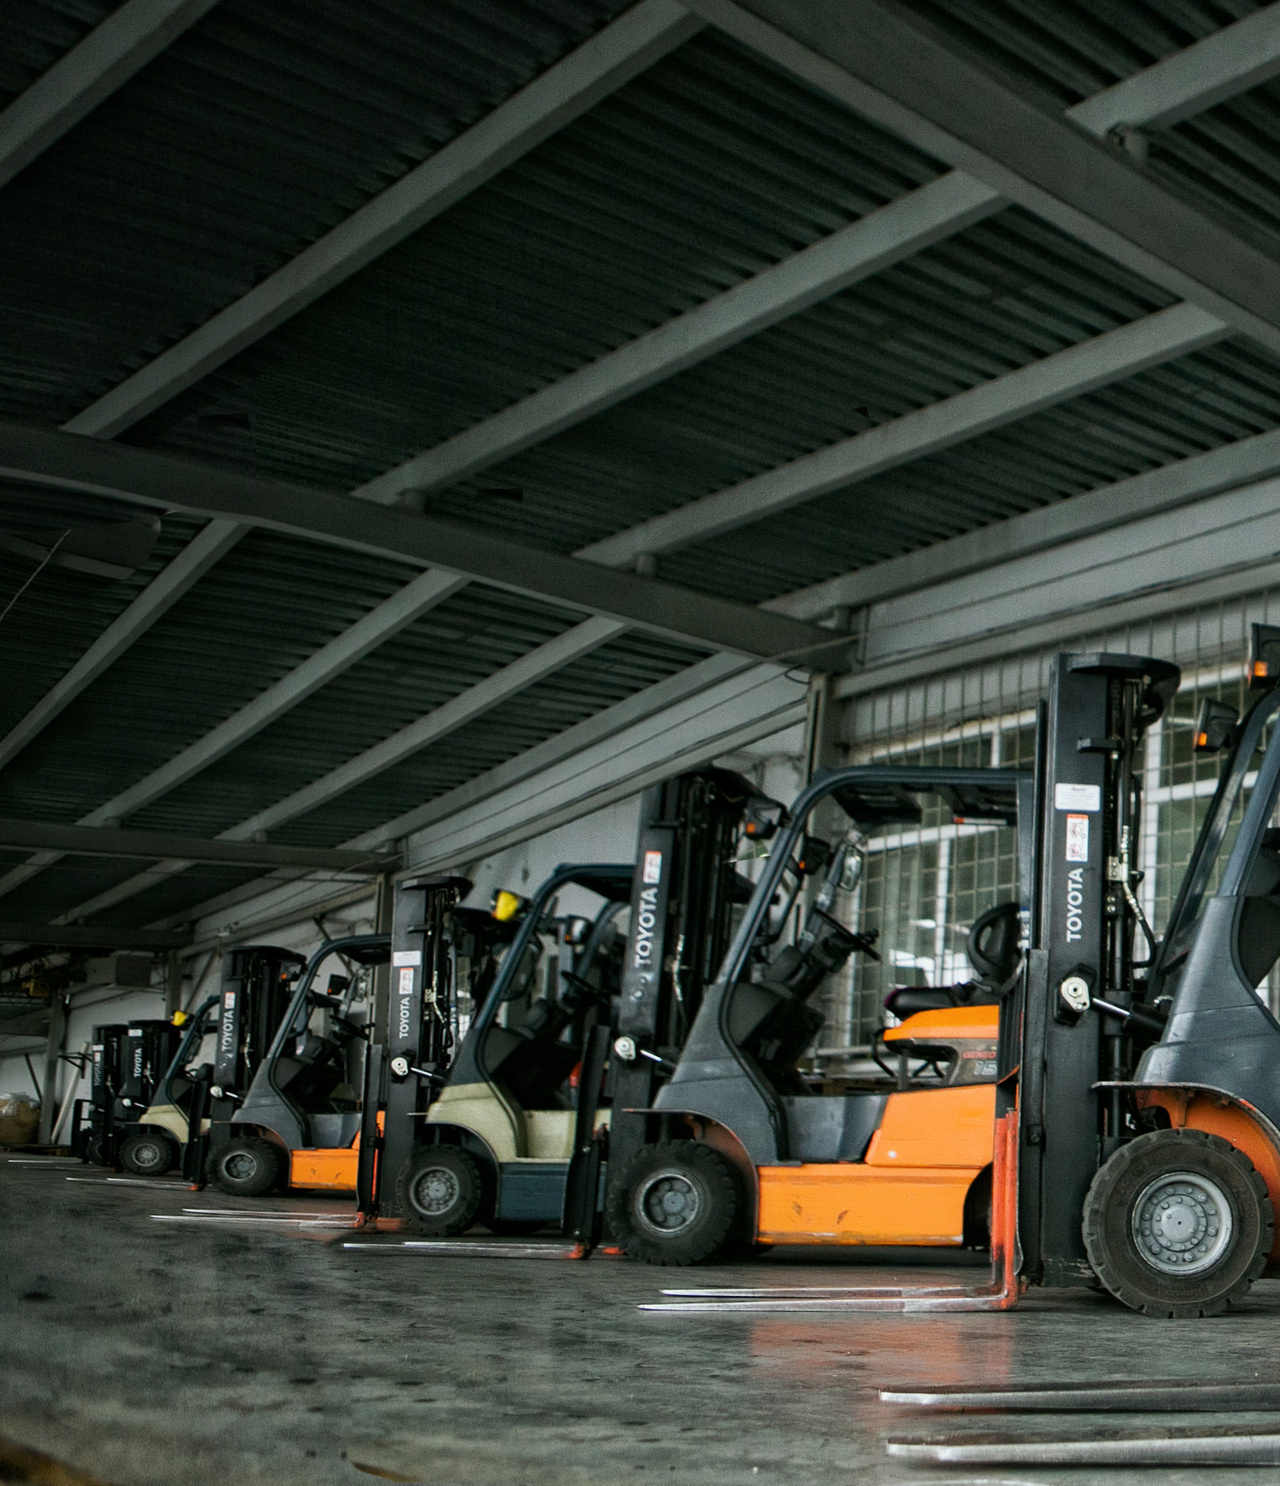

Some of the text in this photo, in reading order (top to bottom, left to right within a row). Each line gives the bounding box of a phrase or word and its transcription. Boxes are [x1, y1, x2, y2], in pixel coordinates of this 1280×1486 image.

[1066, 867, 1084, 943] TOYOTA
[634, 887, 659, 969] TOYOTA
[221, 1009, 235, 1052] TOYOTA
[399, 996, 410, 1039] TOYOTA
[133, 1047, 143, 1078] TOYOTA
